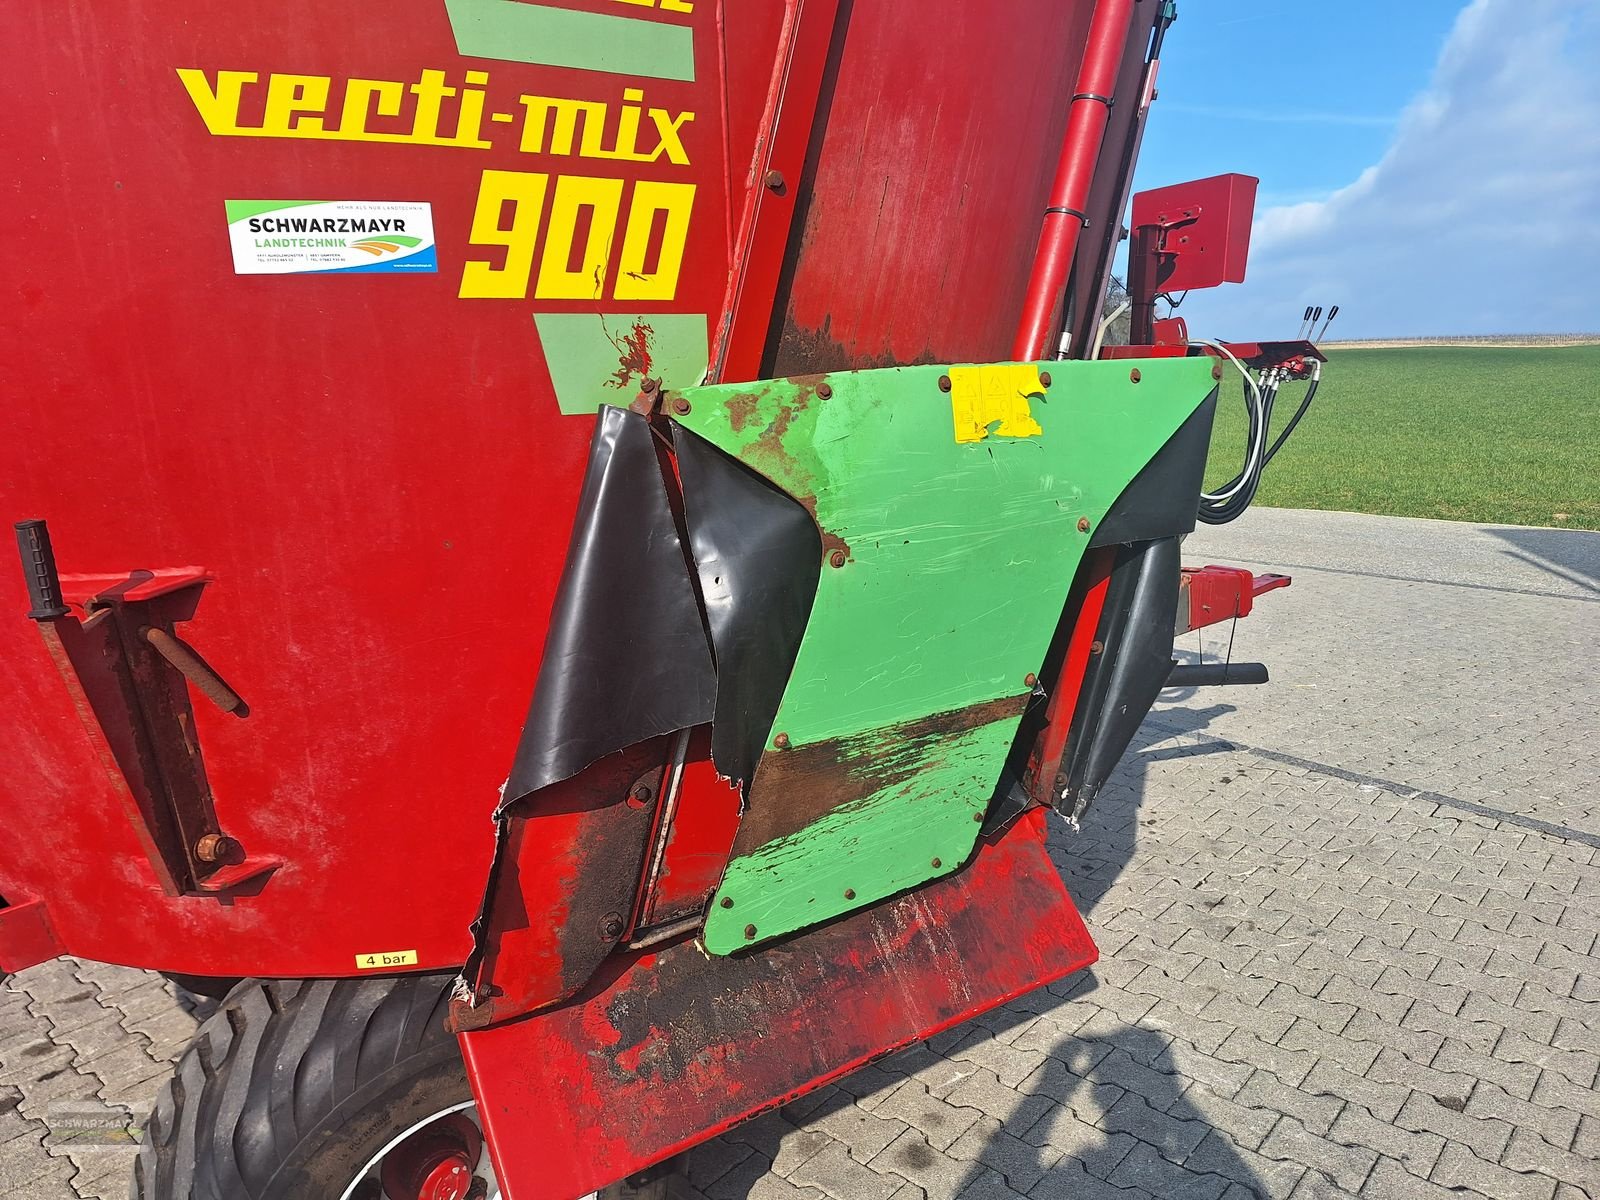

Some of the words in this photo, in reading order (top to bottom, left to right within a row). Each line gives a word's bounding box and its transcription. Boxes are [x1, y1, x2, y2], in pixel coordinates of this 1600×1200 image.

[176, 68, 695, 166] verti-mix
[249, 218, 406, 233] SCHWARZMAYR
[458, 169, 696, 300] 900
[254, 238, 347, 248] LANDTECHNIK
[366, 956, 375, 965] 4
[383, 954, 407, 965] bar
